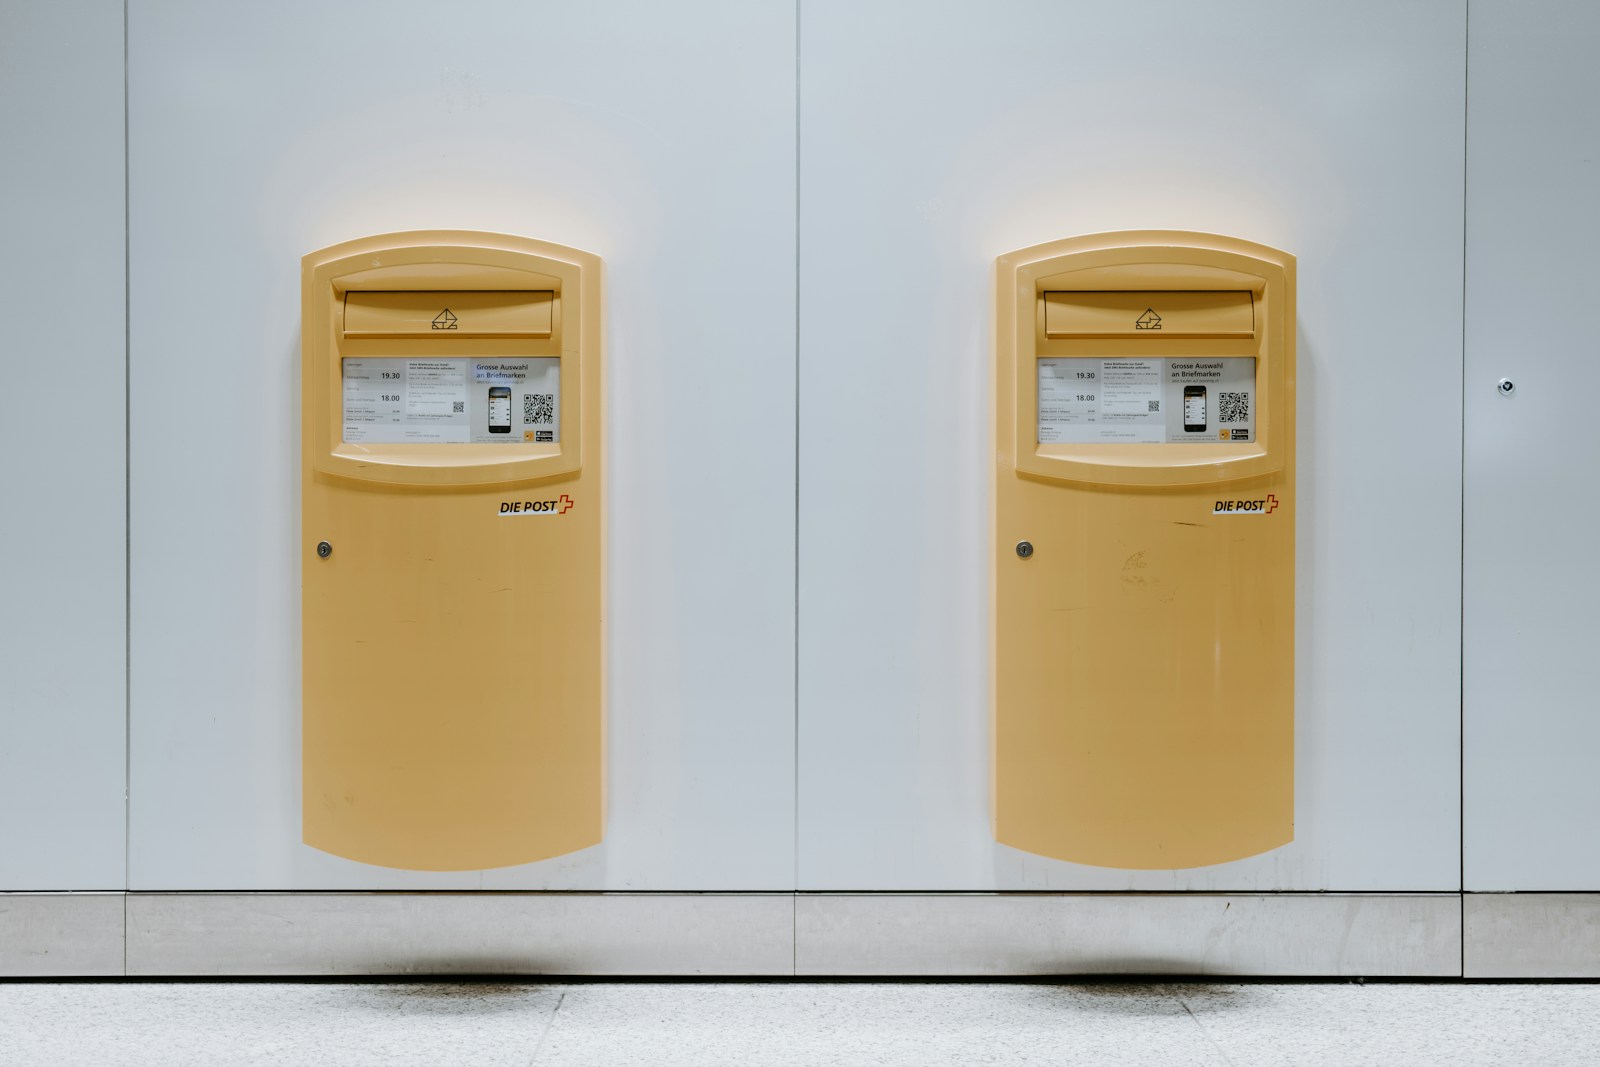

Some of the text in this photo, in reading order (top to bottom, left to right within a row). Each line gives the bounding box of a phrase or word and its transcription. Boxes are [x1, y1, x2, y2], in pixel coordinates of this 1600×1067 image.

[500, 501, 558, 513] DIE POST
[1215, 500, 1265, 511] DIE POST
